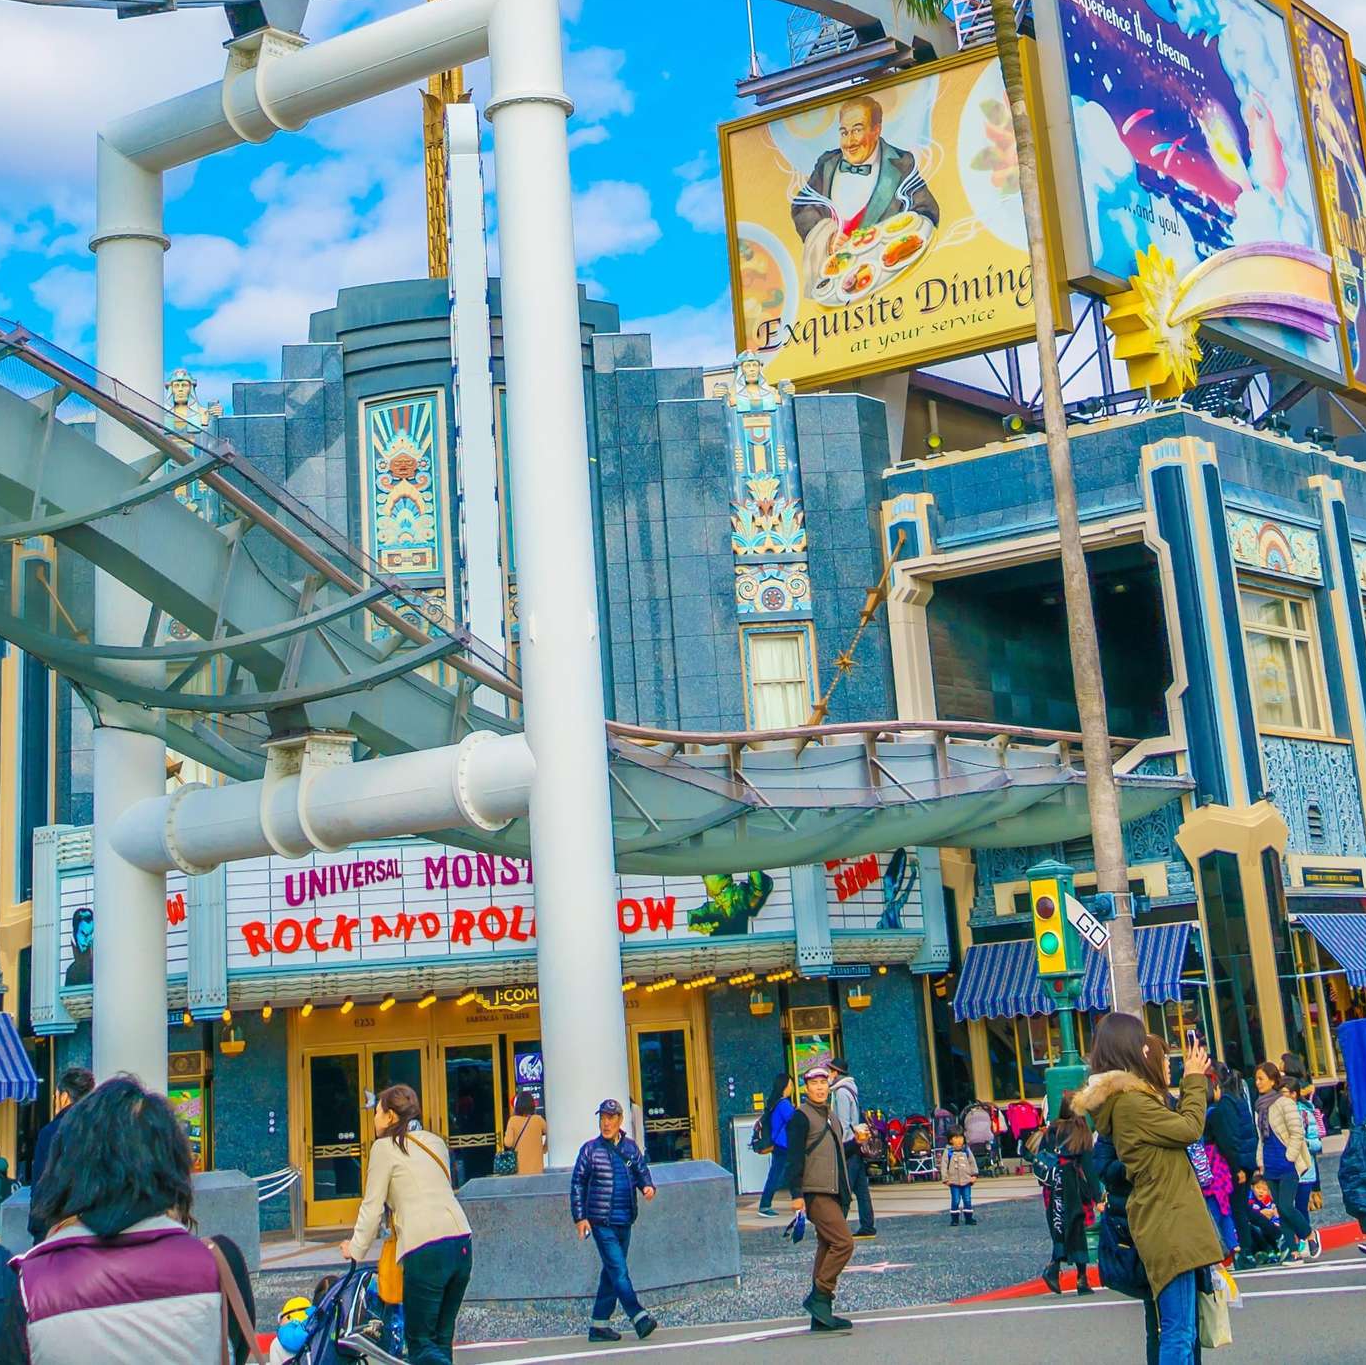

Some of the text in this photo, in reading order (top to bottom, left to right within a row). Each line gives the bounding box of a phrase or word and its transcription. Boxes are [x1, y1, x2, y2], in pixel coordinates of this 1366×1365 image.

[1134, 10, 1153, 48] the
[1156, 23, 1205, 79] dream...
[1159, 211, 1181, 236] you!
[756, 264, 1035, 356] Exquisite Dining
[850, 307, 996, 355] at your service
[285, 858, 403, 907] UNIVERSAL
[834, 853, 880, 902] SHOW
[241, 914, 360, 957] ROCK
[370, 911, 441, 942] AND
[450, 905, 537, 946] ROL
[1076, 912, 1108, 947] GO
[494, 987, 538, 1006] J:COM
